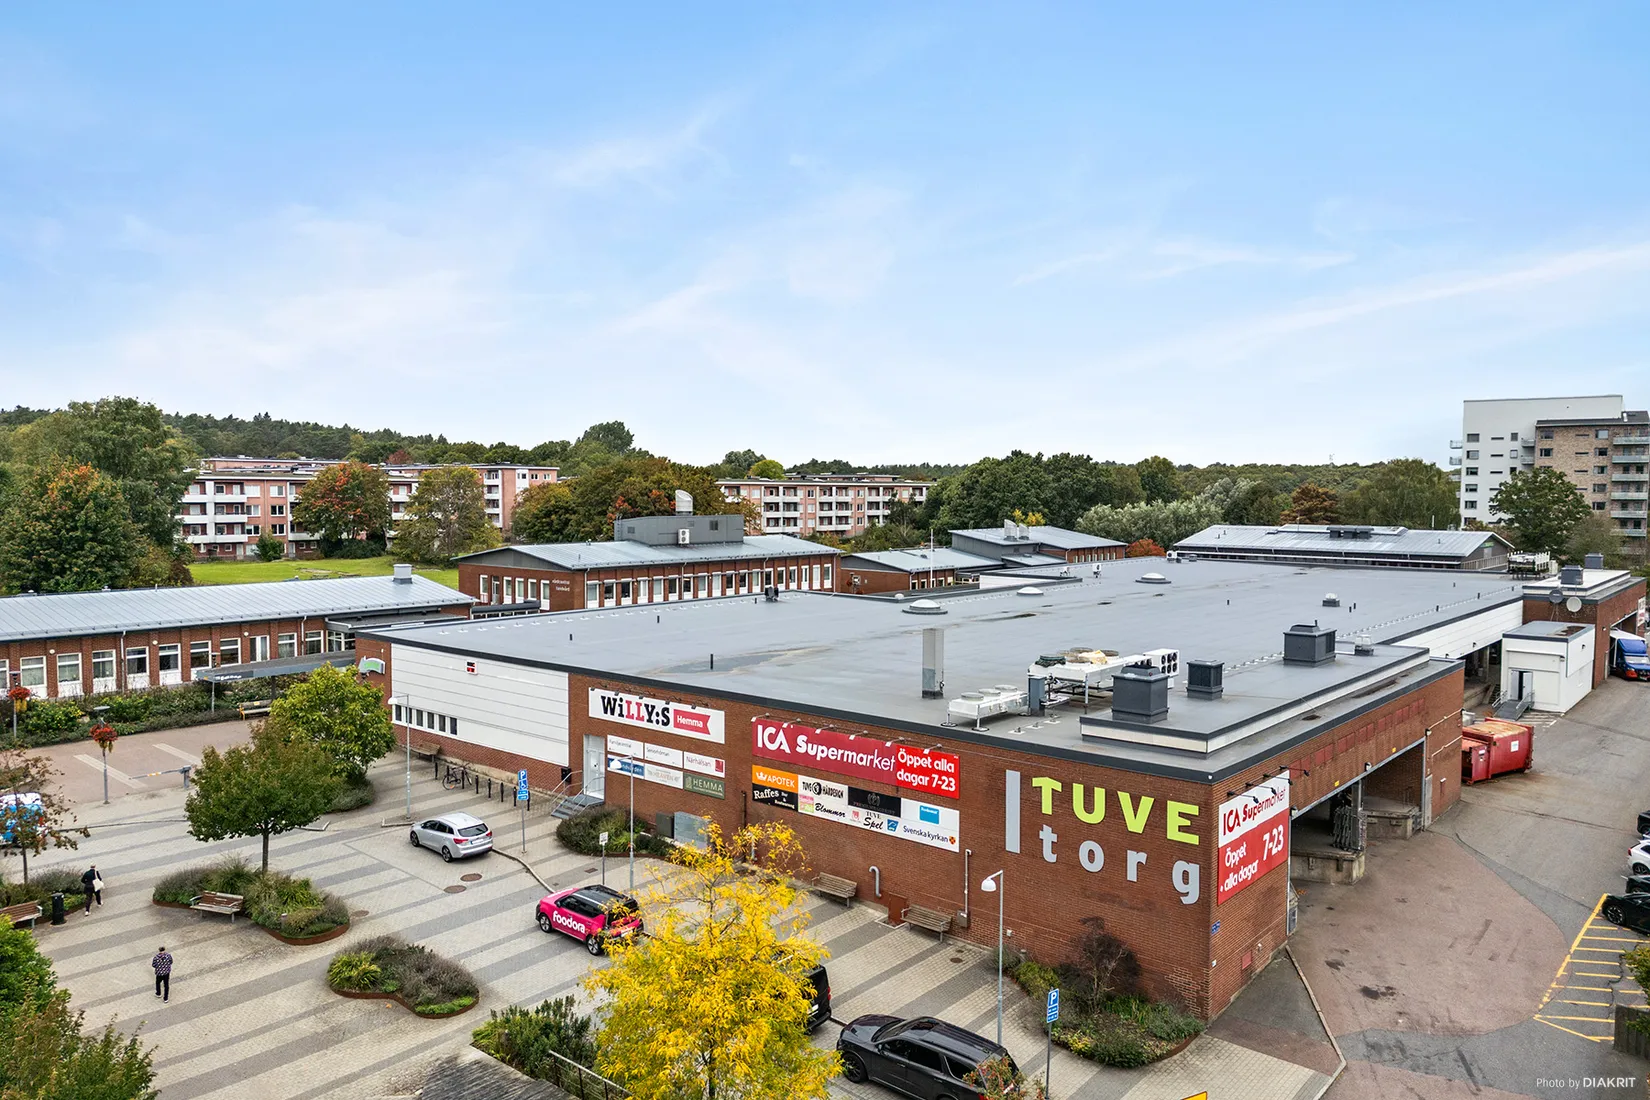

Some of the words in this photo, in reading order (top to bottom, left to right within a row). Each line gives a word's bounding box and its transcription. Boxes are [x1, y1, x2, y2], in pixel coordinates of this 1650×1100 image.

[677, 715, 703, 728] Hemma
[757, 724, 791, 754] ICA
[796, 734, 895, 772] Supermarket
[898, 748, 932, 769] Öppet
[934, 759, 955, 773] alla
[692, 777, 723, 792] HEMMA
[767, 775, 795, 788] APOTEK
[897, 769, 929, 787] dagar
[932, 774, 956, 791] 7-23
[753, 788, 779, 799] Raffes
[1032, 776, 1199, 845] TUVE
[1223, 808, 1241, 836] ICA
[1242, 787, 1286, 822] Supermarket
[863, 817, 884, 829] Spel
[903, 825, 927, 837] Svenska
[927, 831, 948, 843] kyrkan
[1225, 841, 1246, 868] Öppet
[1262, 824, 1284, 861] 7-23
[1039, 824, 1200, 905] torg
[1224, 872, 1238, 892] alla
[1239, 859, 1259, 883] dagar
[553, 910, 585, 934] foodora
[1050, 992, 1057, 1005] P
